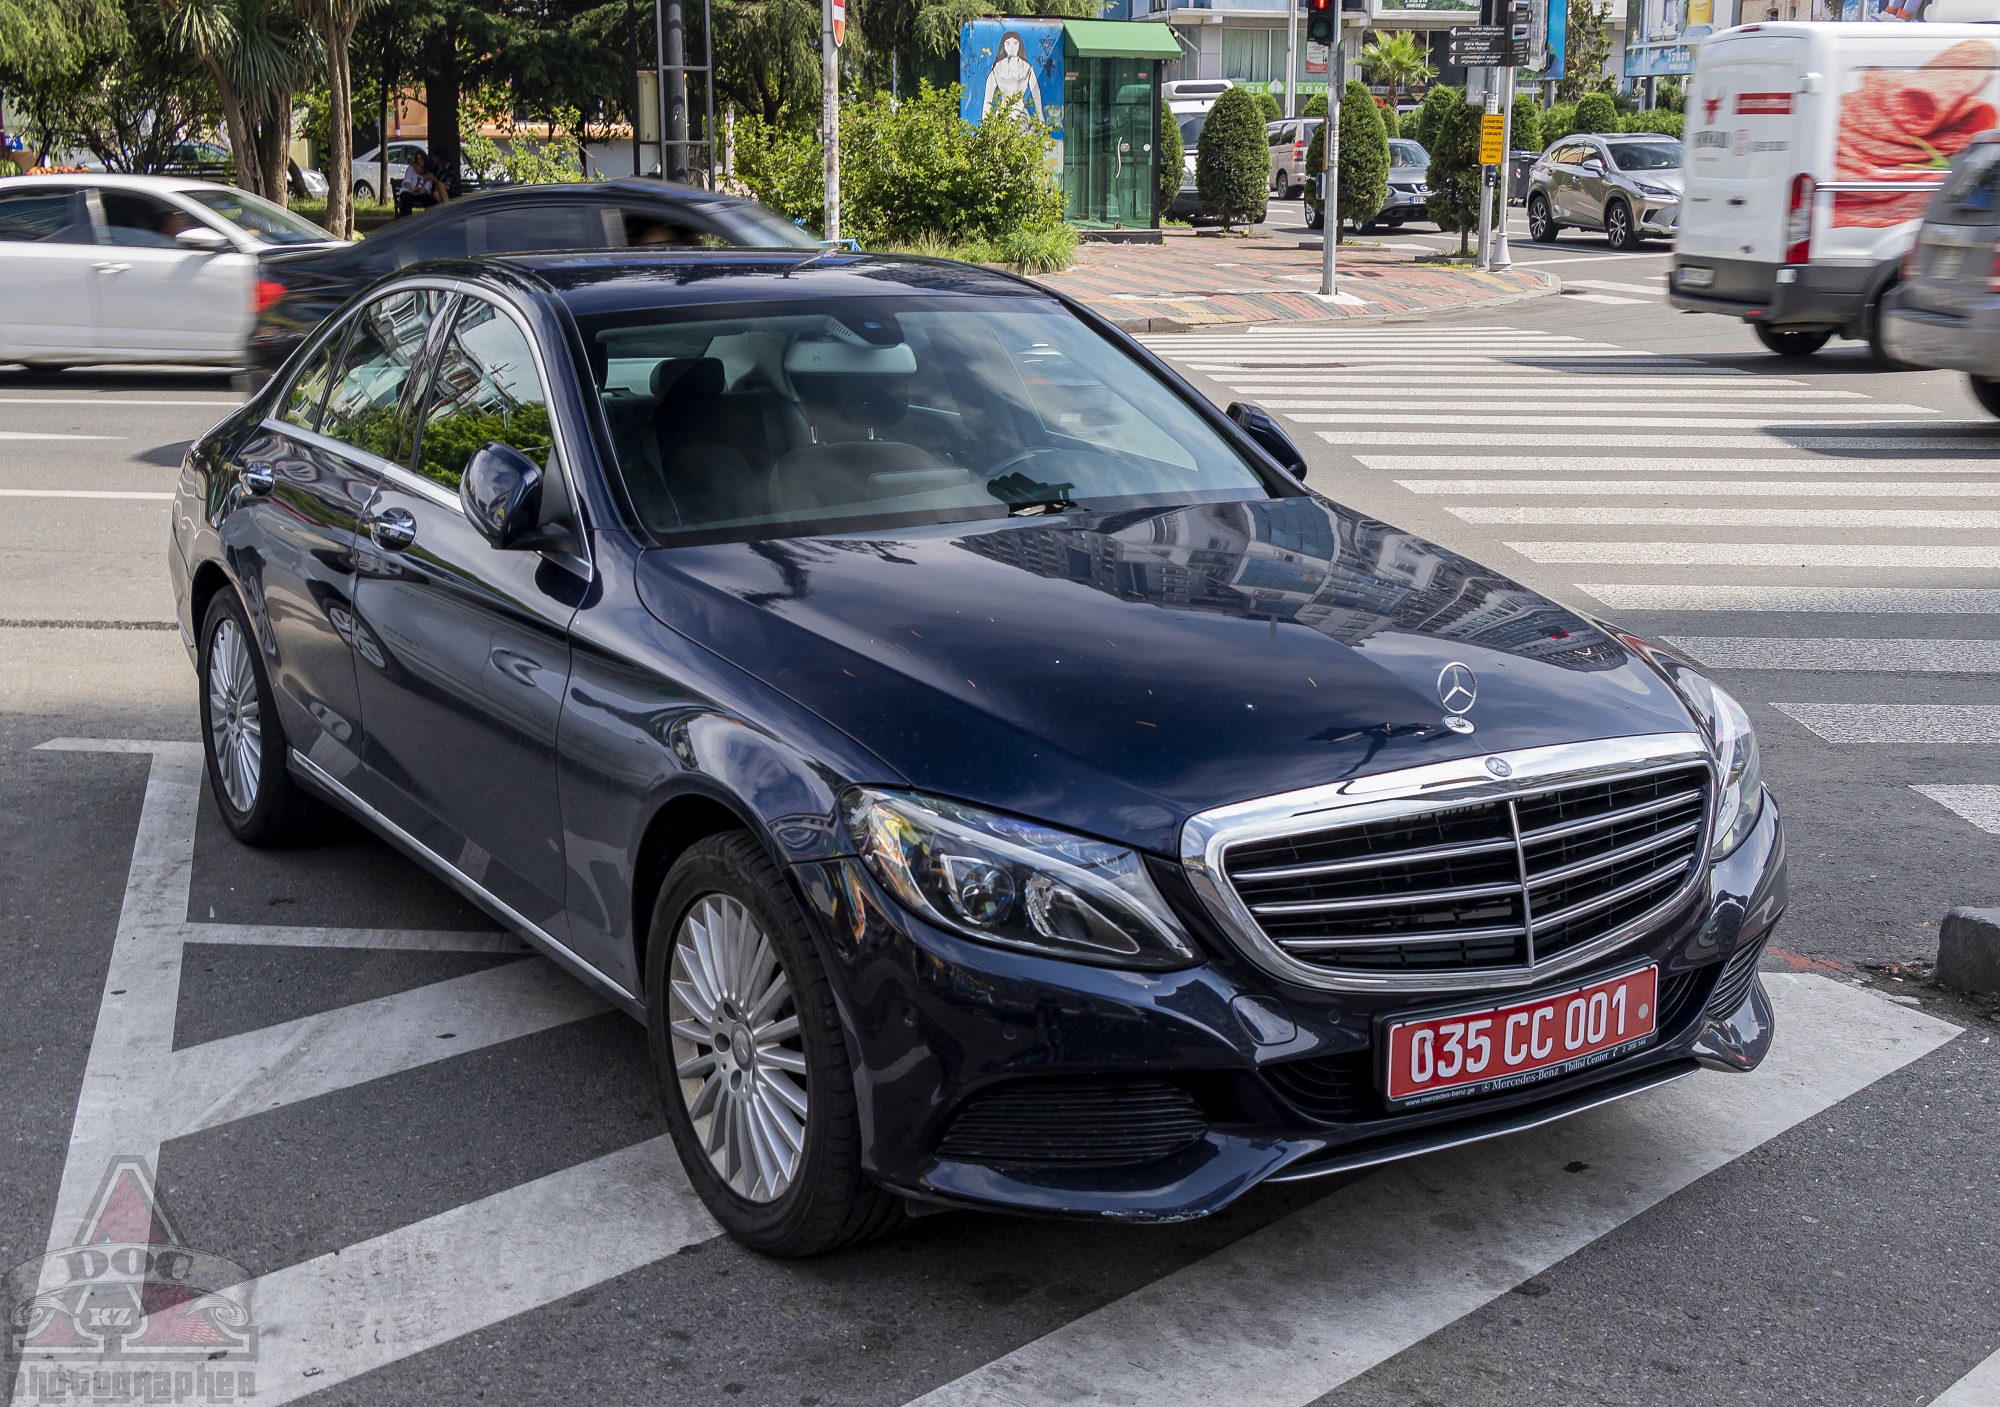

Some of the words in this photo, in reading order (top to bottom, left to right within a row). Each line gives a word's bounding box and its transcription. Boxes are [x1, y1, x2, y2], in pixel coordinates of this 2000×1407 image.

[1410, 1018, 1493, 1083] 035
[1503, 1006, 1554, 1066] CC
[1564, 984, 1628, 1051] 001
[1405, 1087, 1475, 1106] www.mercedes-benz.ge
[1491, 1067, 1560, 1091] Mercedes-Benz
[1563, 1058, 1587, 1073] Tbilisi
[1587, 1051, 1610, 1066] Center
